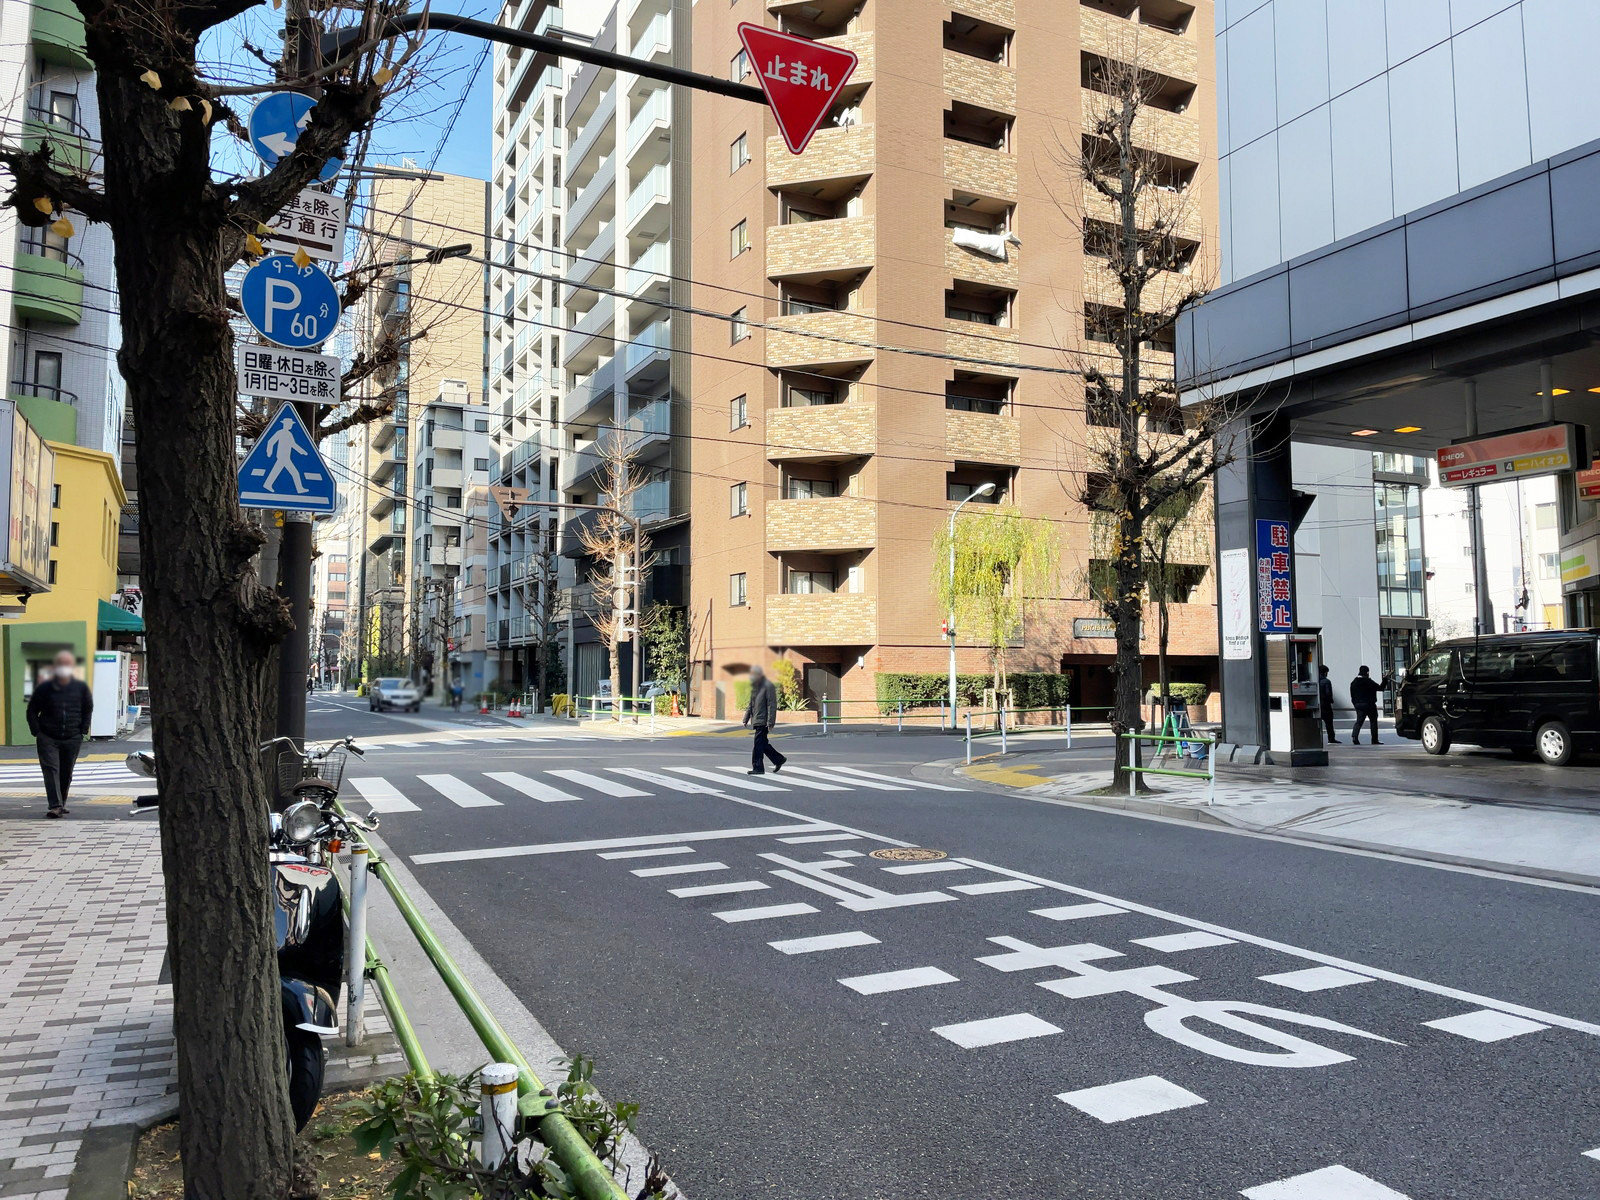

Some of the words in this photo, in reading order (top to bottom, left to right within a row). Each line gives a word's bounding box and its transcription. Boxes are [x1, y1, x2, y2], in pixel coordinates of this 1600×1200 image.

[764, 54, 832, 91] 止まれ
[264, 277, 302, 333] P
[1440, 451, 1465, 462] ENEOS
[1441, 473, 1448, 482] 3
[1461, 465, 1494, 479] レギュラー
[1505, 462, 1513, 471] 4
[1271, 525, 1291, 628] 駐車禁止
